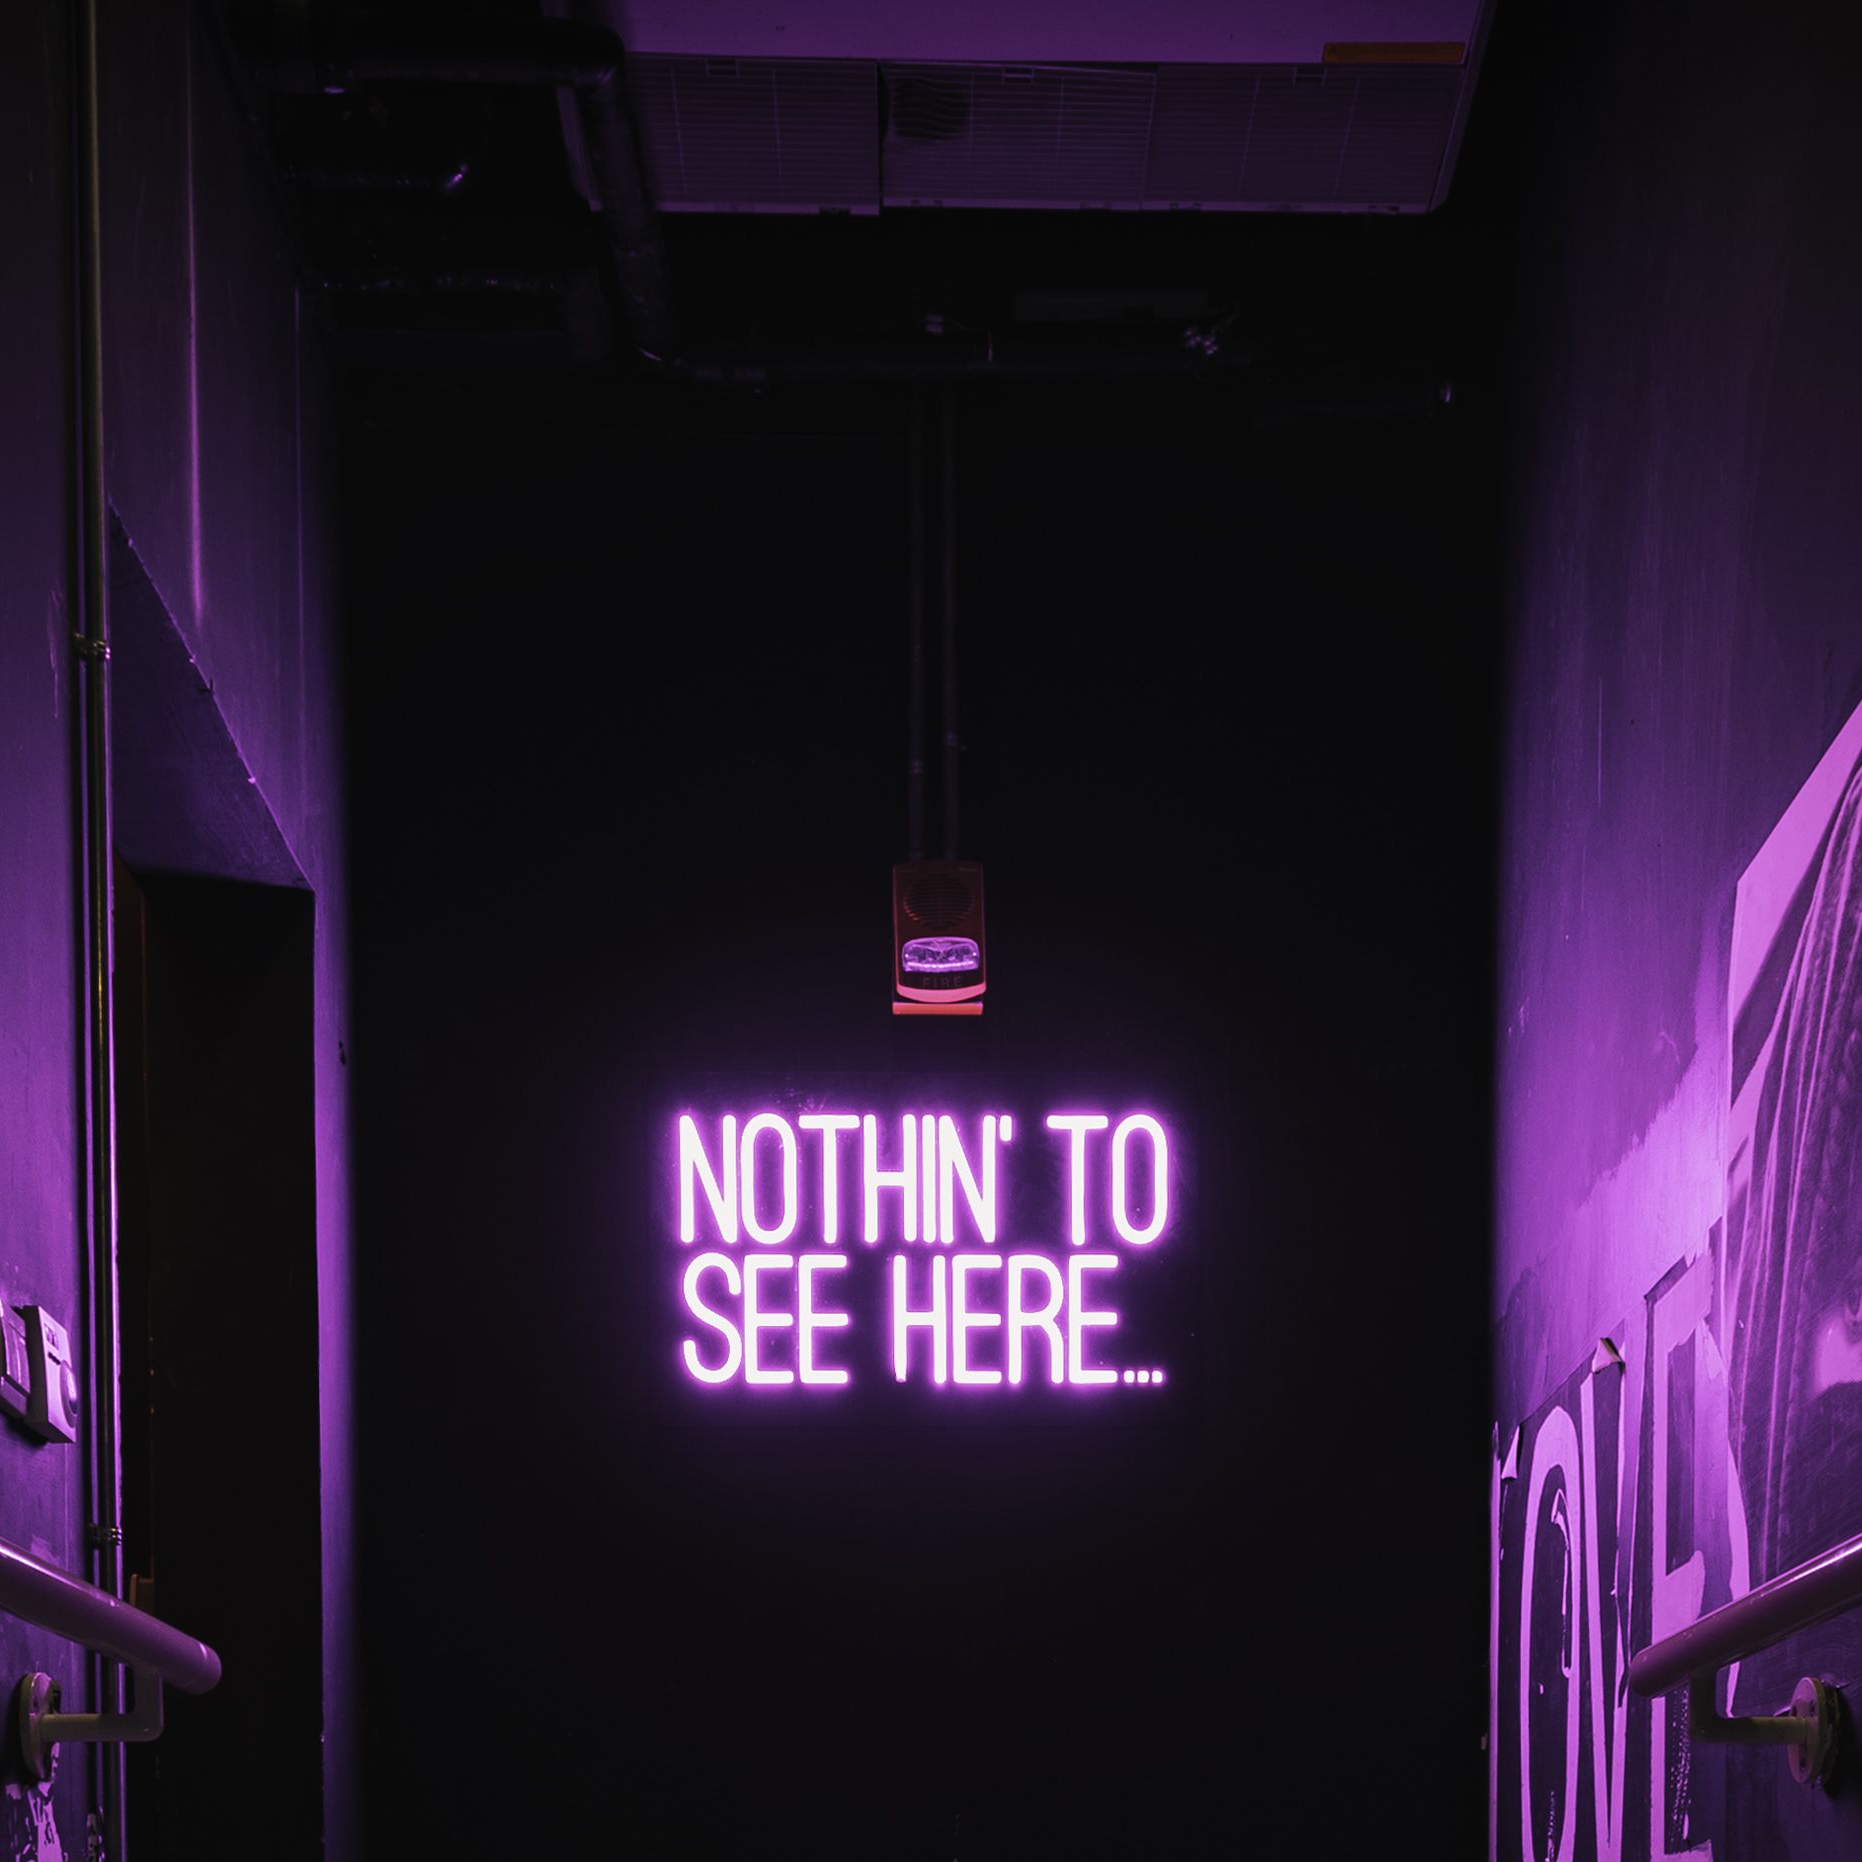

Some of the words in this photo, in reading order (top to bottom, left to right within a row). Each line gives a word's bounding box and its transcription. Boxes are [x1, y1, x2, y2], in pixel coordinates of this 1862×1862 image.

[922, 976, 963, 989] FIRE
[679, 1113, 1013, 1244] NOTHIN'
[1046, 1114, 1169, 1246] TO
[682, 1252, 849, 1385] SEE
[893, 1254, 1164, 1385] HERE...
